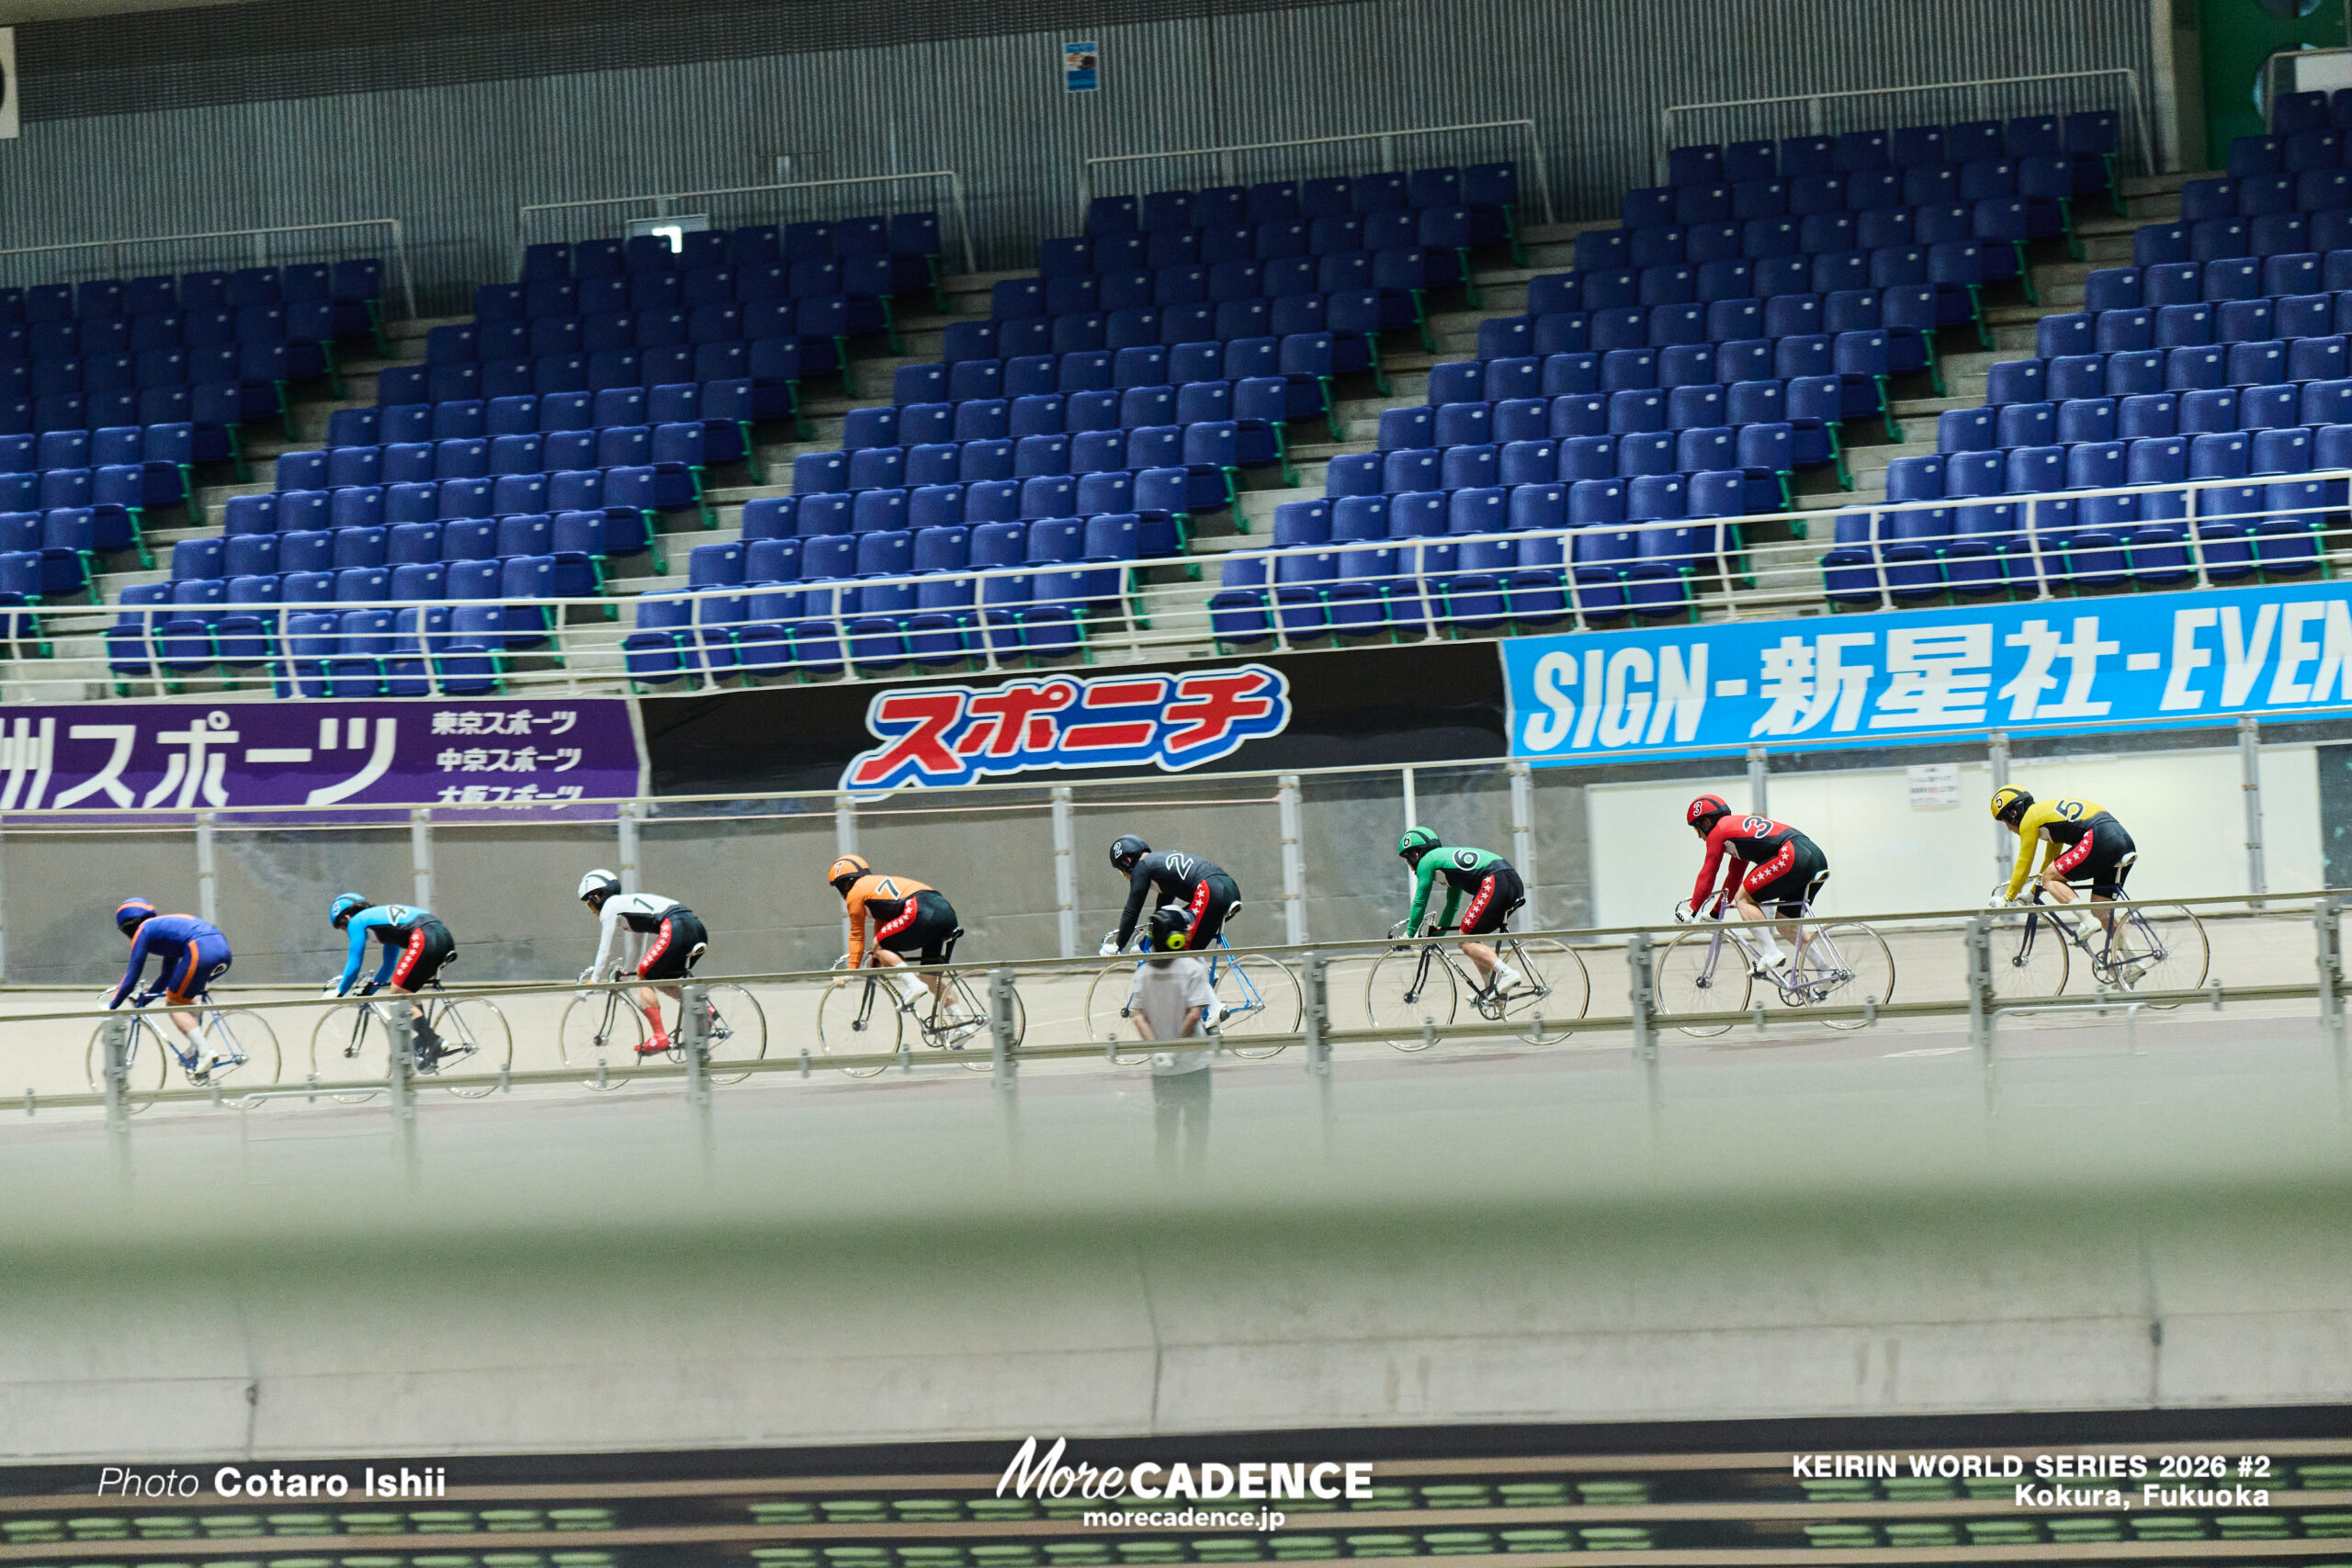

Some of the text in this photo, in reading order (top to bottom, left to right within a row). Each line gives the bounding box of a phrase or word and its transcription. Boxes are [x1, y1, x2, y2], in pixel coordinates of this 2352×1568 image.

[431, 708, 577, 735] 東京スポーツ
[842, 668, 1283, 794] スポニチ
[436, 746, 582, 772] 中京スポーツ
[1692, 801, 1702, 817] 3
[1995, 794, 2004, 809] 5
[2054, 799, 2085, 822] 5
[1742, 816, 1773, 839] 3
[1114, 841, 1123, 859] 2
[1402, 833, 1411, 849] 6
[834, 861, 843, 876] 7
[1166, 852, 1193, 881] 2
[1453, 848, 1480, 872] 6
[876, 877, 900, 900] 7
[633, 897, 655, 912] 1
[387, 906, 410, 927] 4
